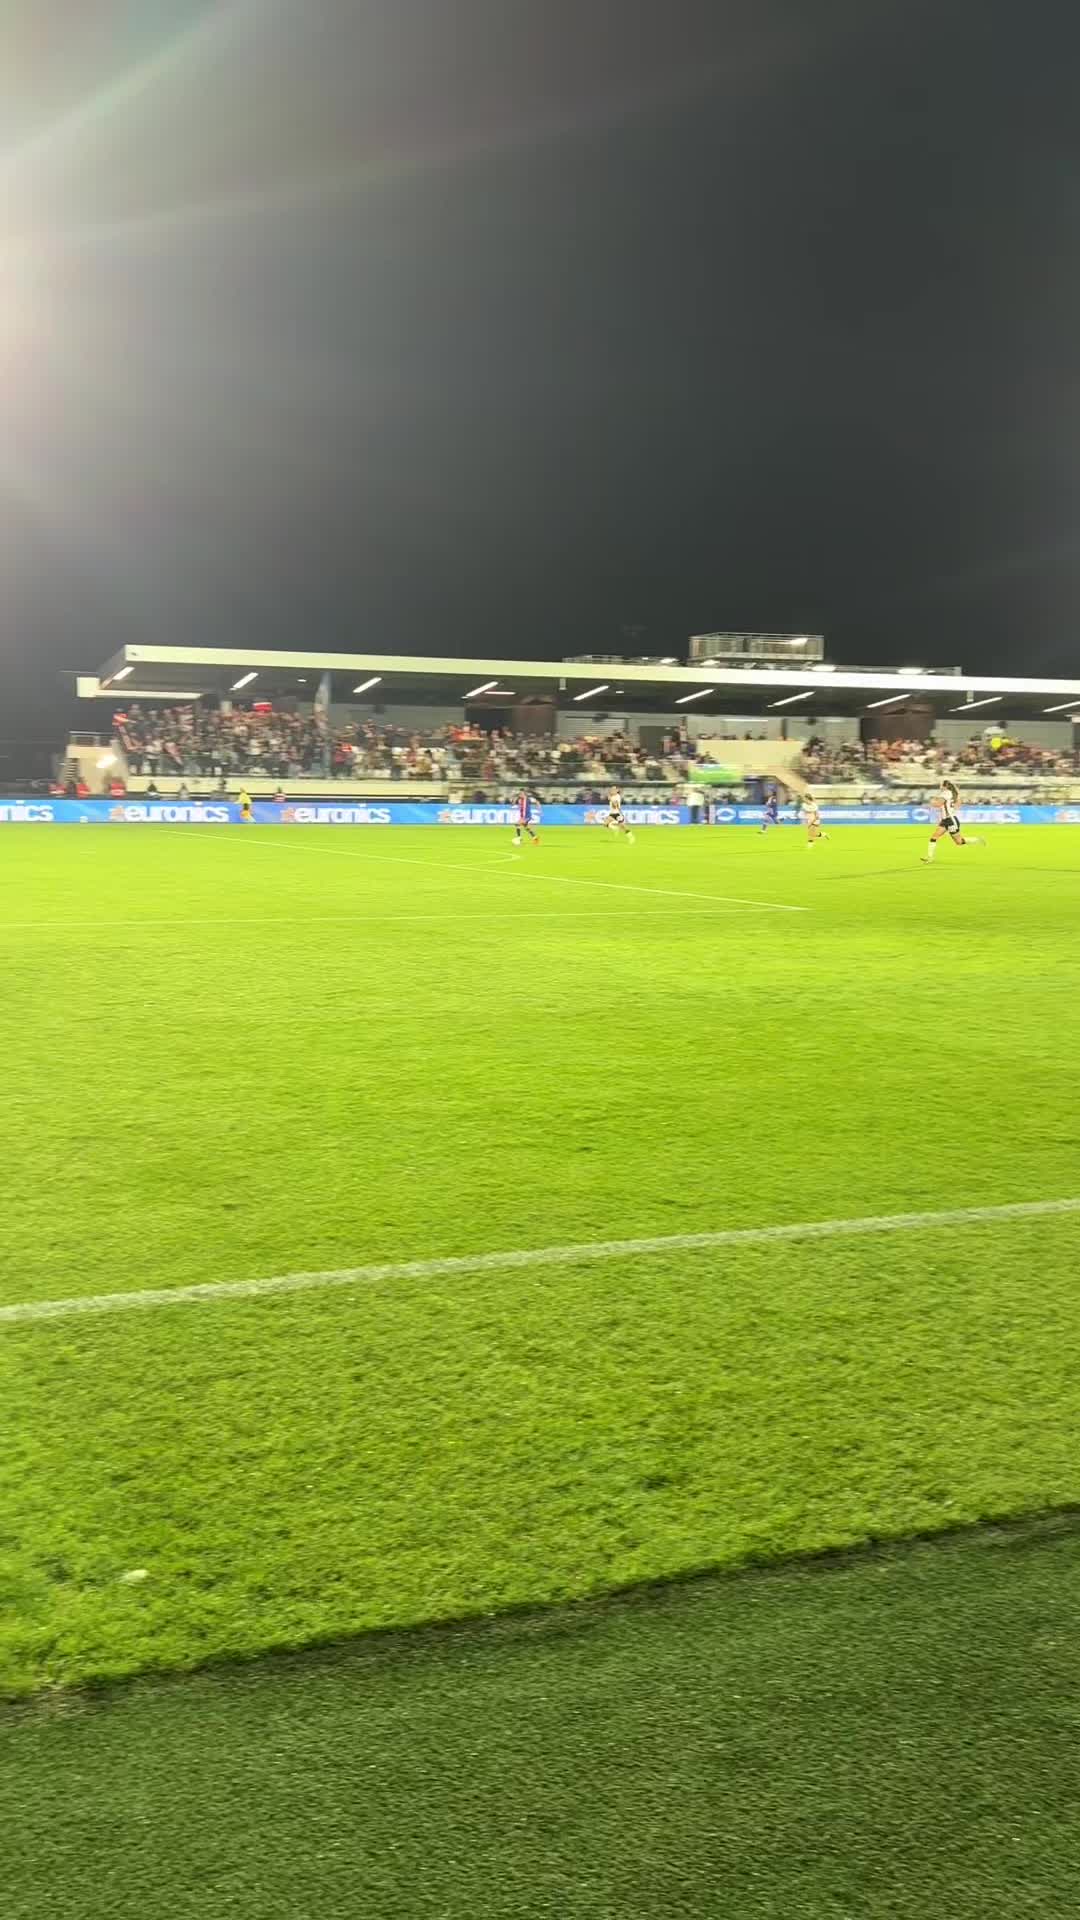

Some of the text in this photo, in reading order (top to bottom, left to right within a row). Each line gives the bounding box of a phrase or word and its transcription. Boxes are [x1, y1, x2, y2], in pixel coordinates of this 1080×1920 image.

[124, 801, 229, 822] euronics
[294, 803, 391, 823] euronics
[449, 804, 541, 824] euronis
